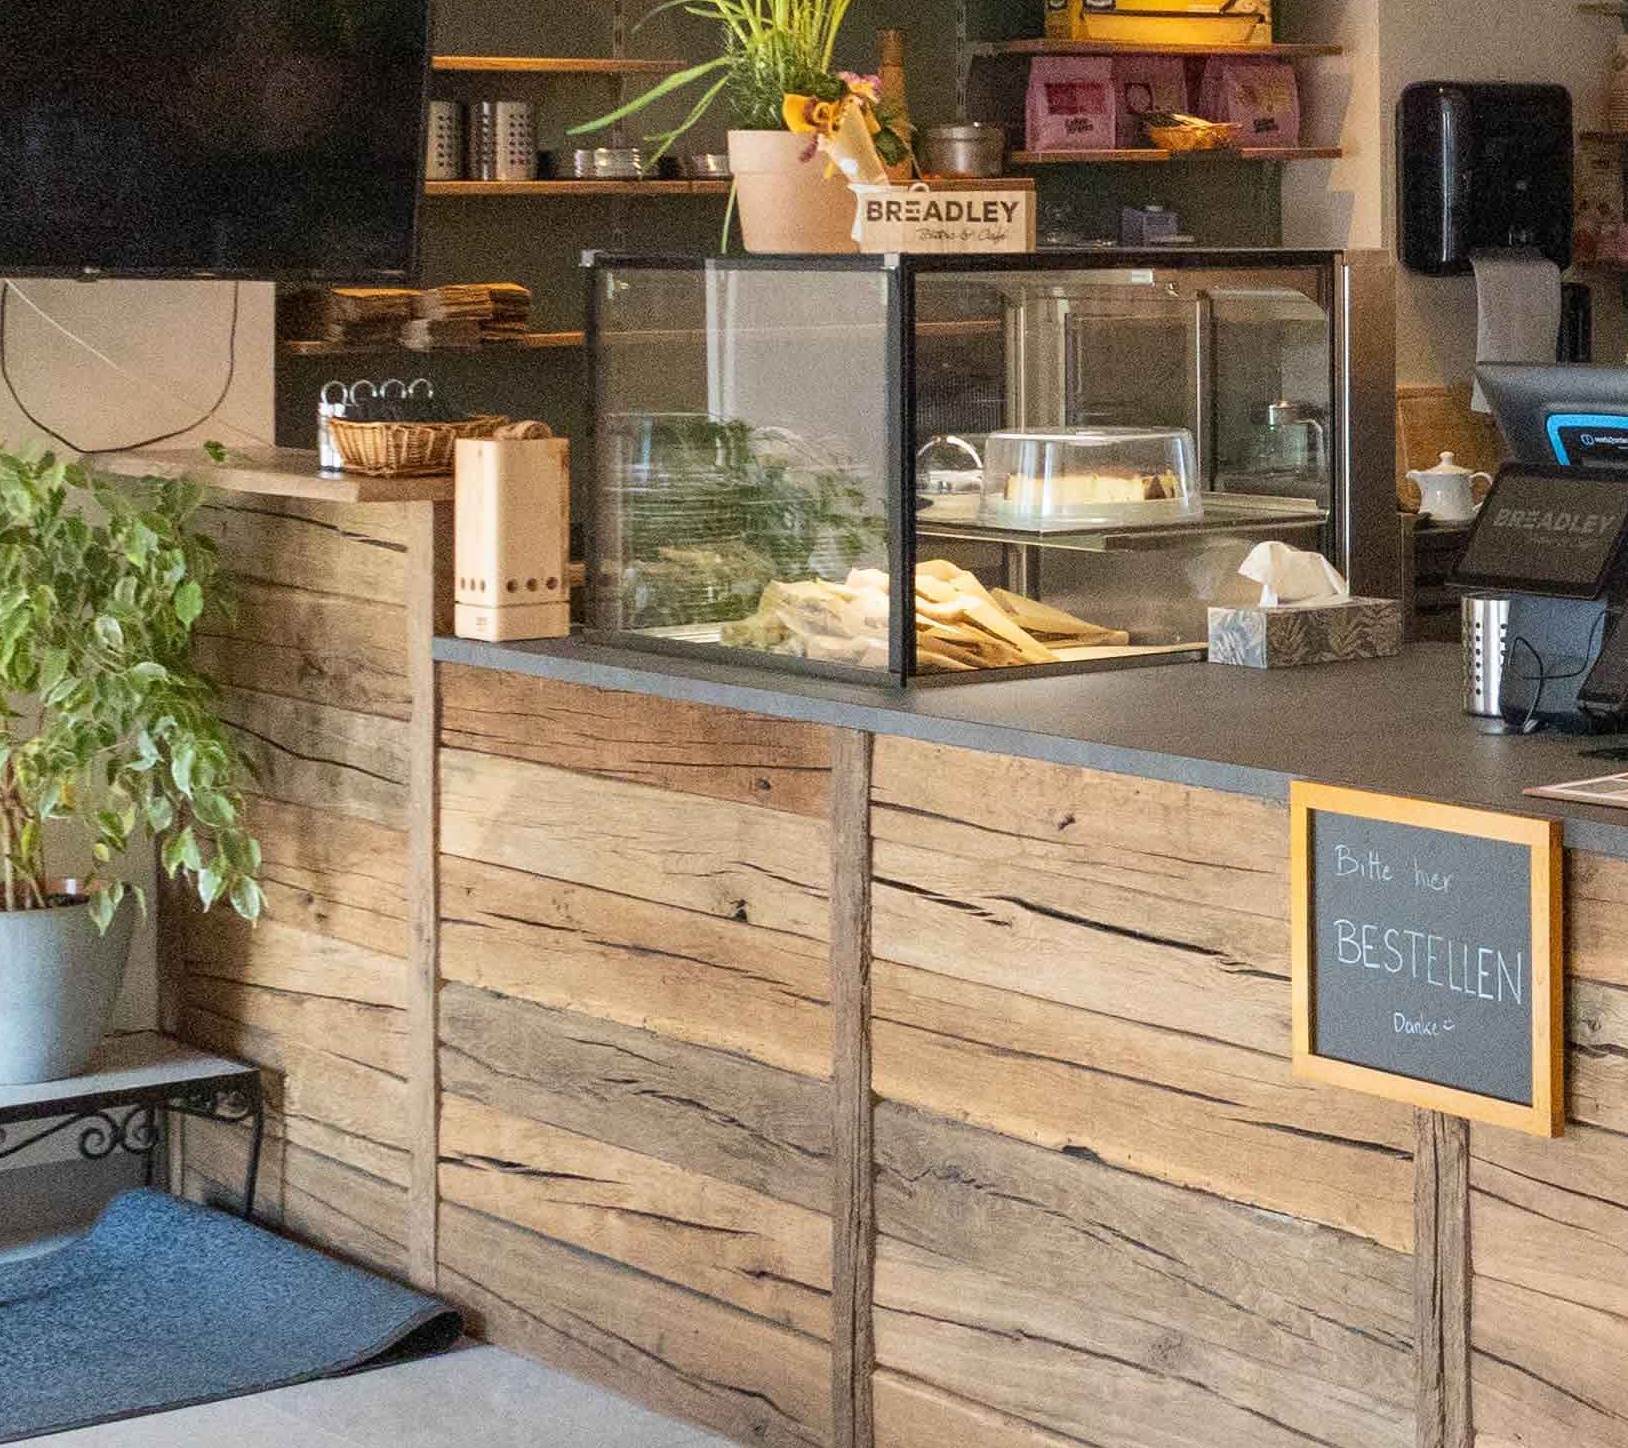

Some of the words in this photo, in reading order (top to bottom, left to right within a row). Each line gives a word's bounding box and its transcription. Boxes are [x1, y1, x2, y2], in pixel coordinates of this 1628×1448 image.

[866, 200, 1020, 223] BREADLEY
[1492, 507, 1616, 535] BREADLEY
[1334, 843, 1394, 881] Bitte
[1412, 856, 1454, 893] hier
[1332, 918, 1523, 1005] BESTELLEN
[1393, 1011, 1440, 1036] Danke
